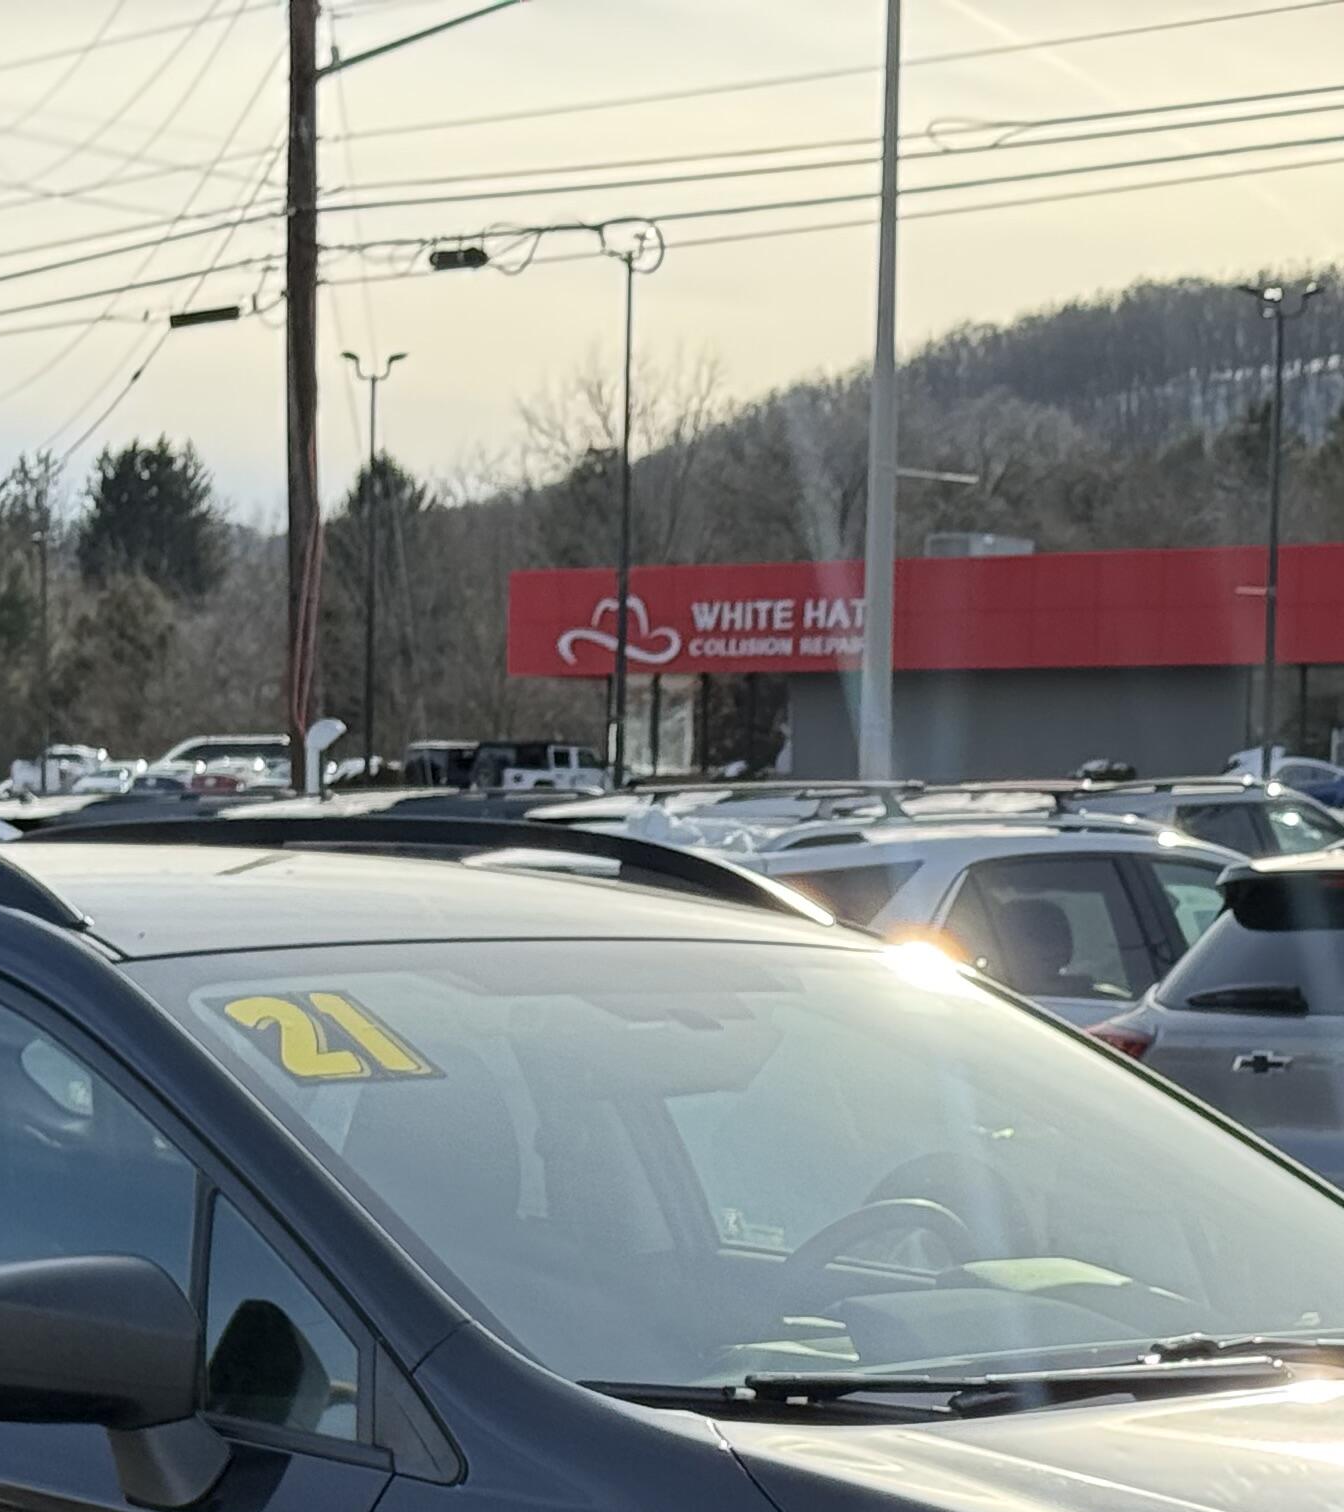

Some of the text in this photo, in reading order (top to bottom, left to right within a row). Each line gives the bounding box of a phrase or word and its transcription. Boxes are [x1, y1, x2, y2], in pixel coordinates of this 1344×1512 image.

[691, 598, 865, 631] WHITE HAT
[688, 636, 793, 657] COLLISION
[224, 992, 432, 1078] 21
